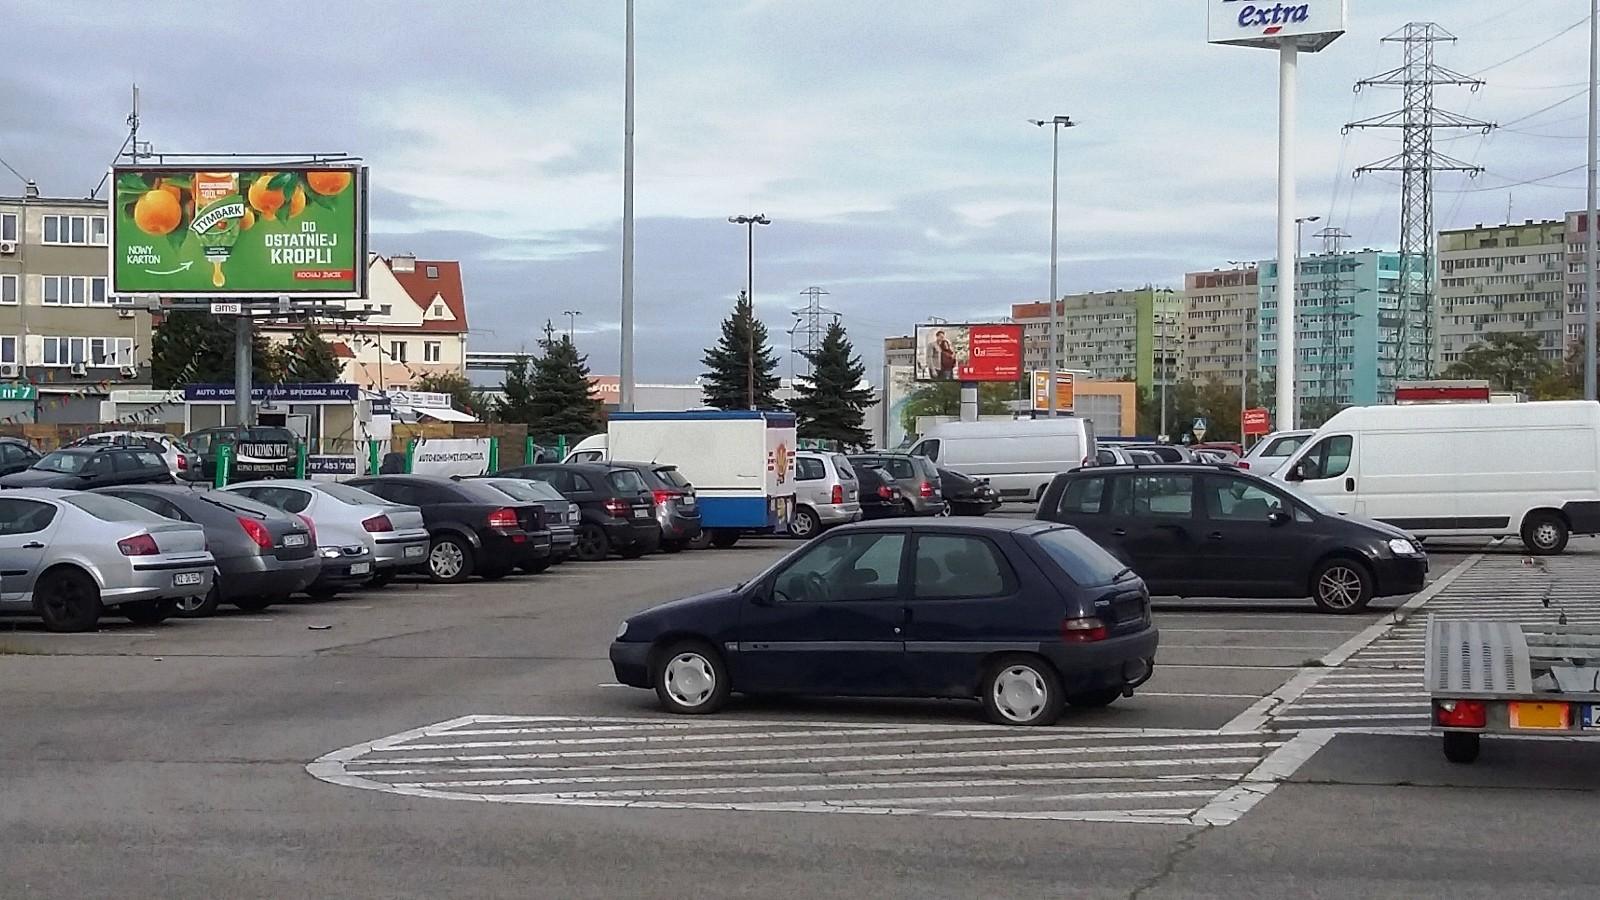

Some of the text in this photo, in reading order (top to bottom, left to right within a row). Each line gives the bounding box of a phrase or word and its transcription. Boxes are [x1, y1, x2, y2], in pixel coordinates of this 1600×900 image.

[1239, 3, 1308, 27] extra
[195, 204, 242, 231] TYMBARK
[302, 221, 316, 232] DO
[265, 233, 337, 246] OSTATNIEJ
[128, 246, 153, 255] NOWY
[271, 248, 332, 264] KROPLI
[127, 254, 160, 264] KARTON
[214, 304, 237, 312] ams
[22, 386, 31, 398] 7
[196, 388, 216, 396] AUTO
